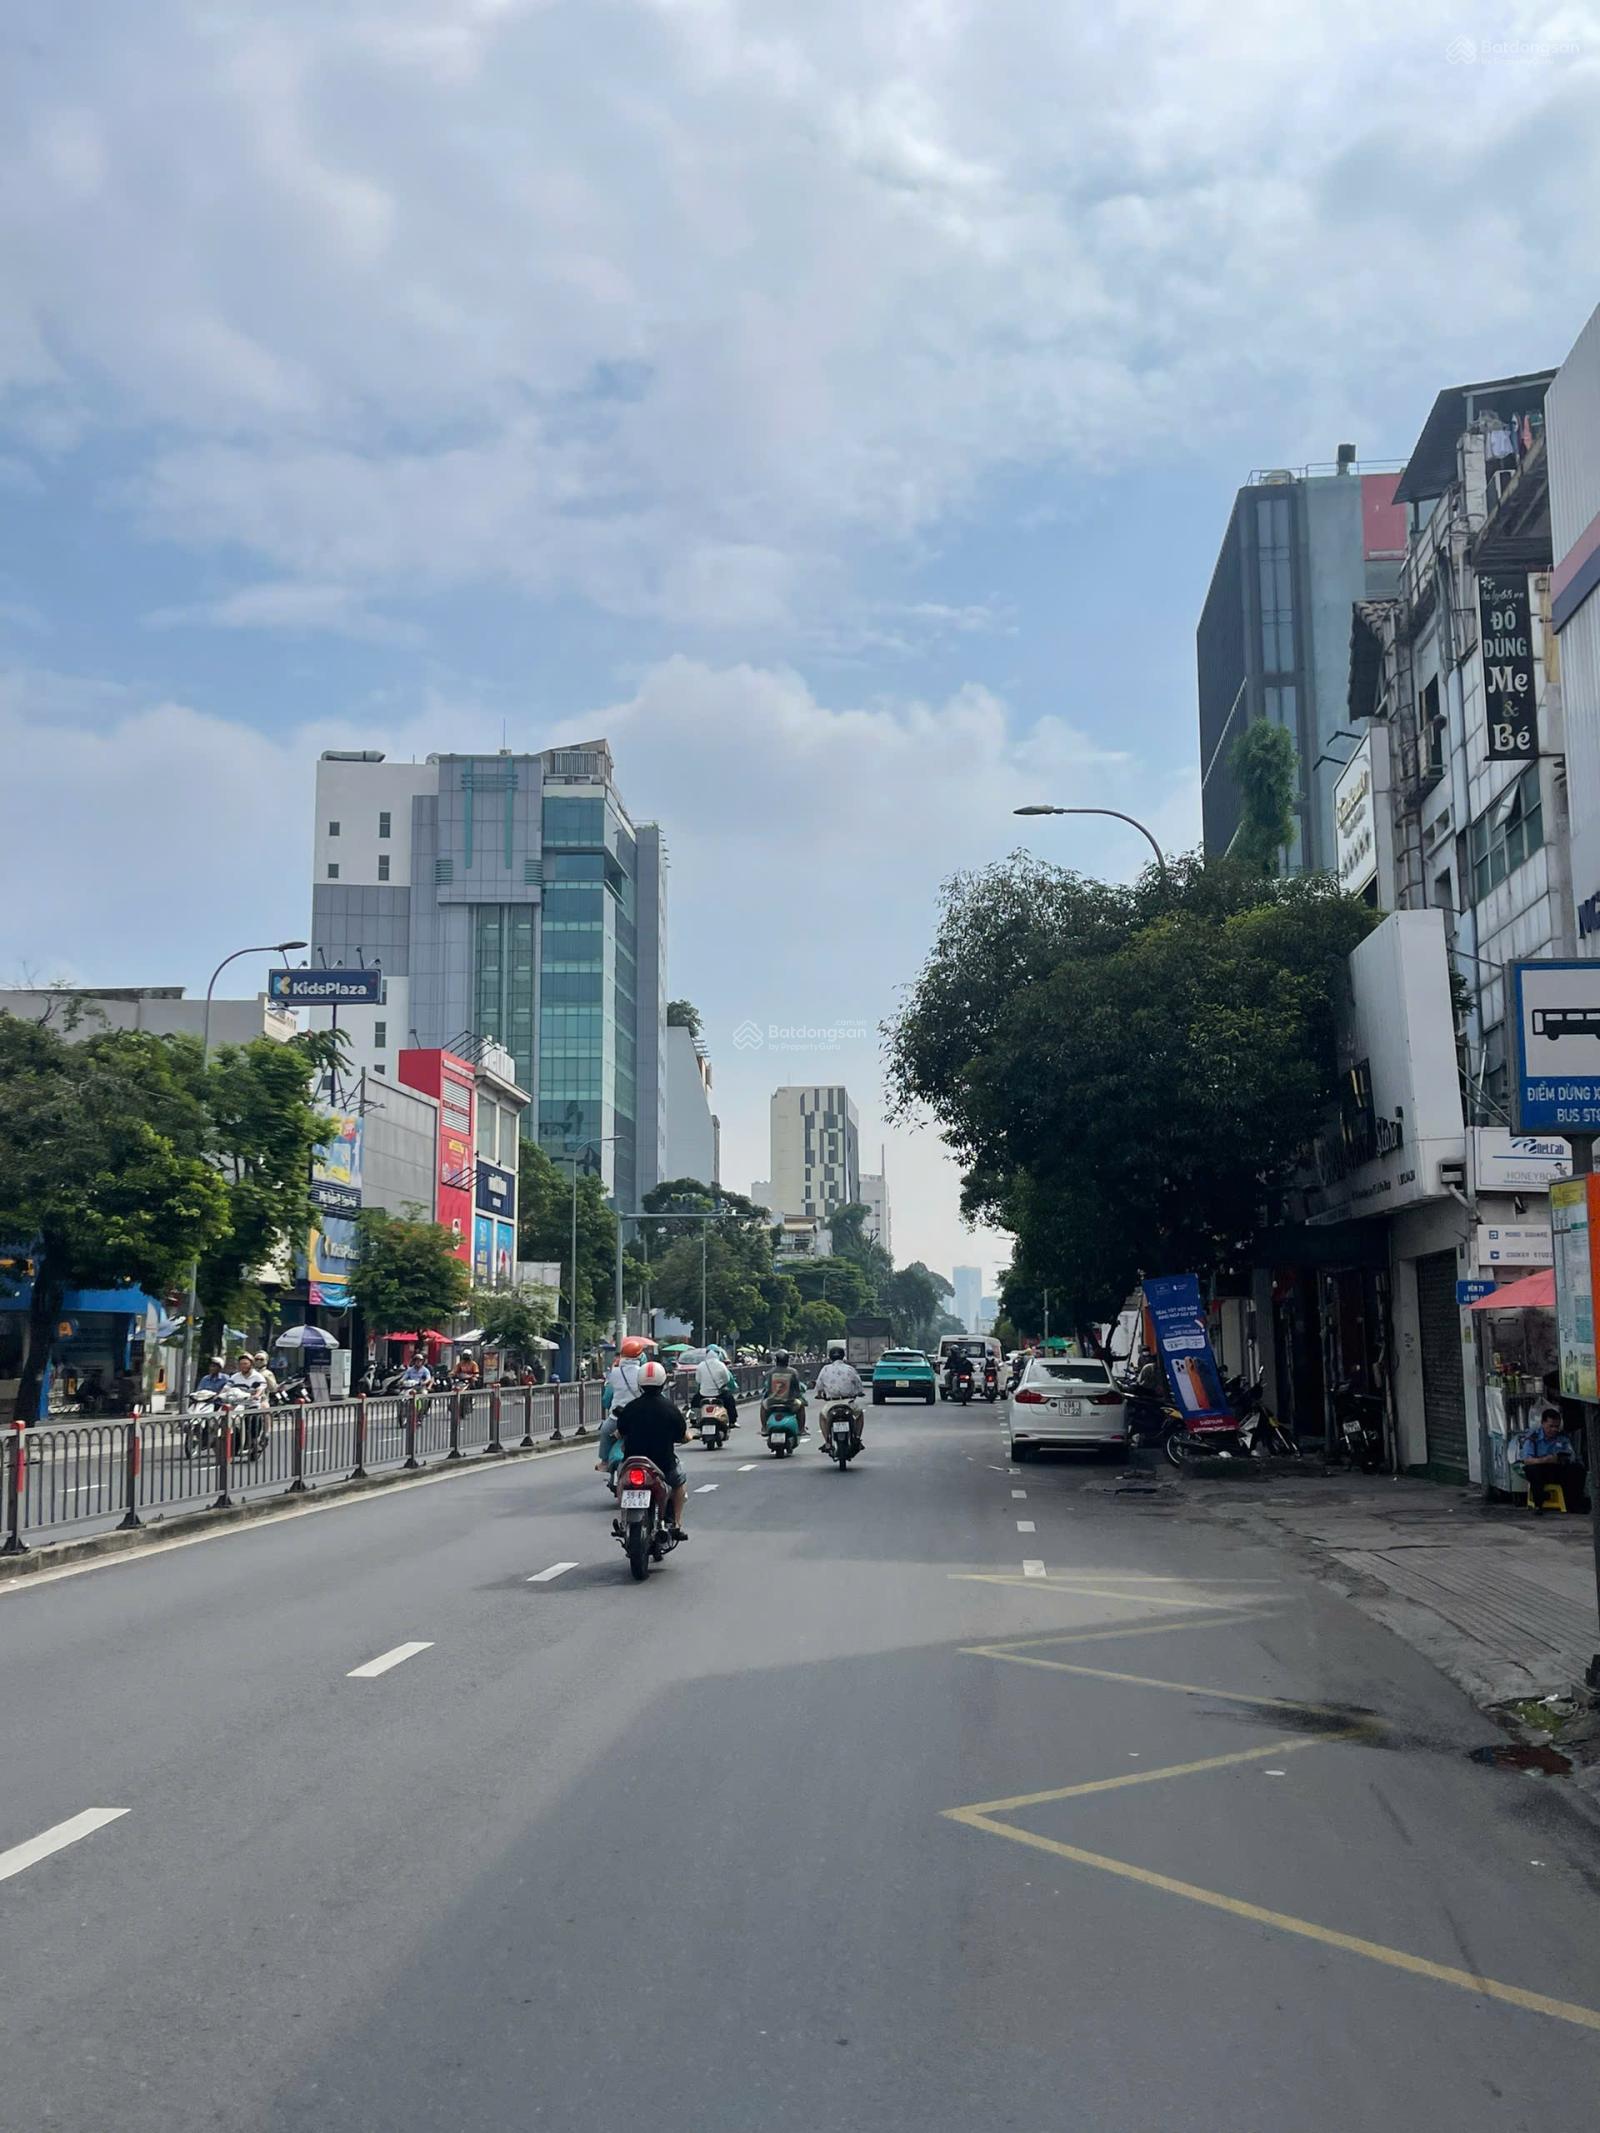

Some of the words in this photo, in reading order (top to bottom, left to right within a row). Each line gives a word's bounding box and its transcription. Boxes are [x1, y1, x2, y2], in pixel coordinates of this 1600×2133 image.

[1490, 603, 1516, 630] ĐỒ
[1484, 633, 1527, 658] DÙNG
[1488, 665, 1528, 698] Mẹ
[1503, 701, 1520, 717] &
[1493, 723, 1531, 751] Bé
[293, 982, 367, 994] KidsPlaza
[1557, 1107, 1580, 1122] BUS
